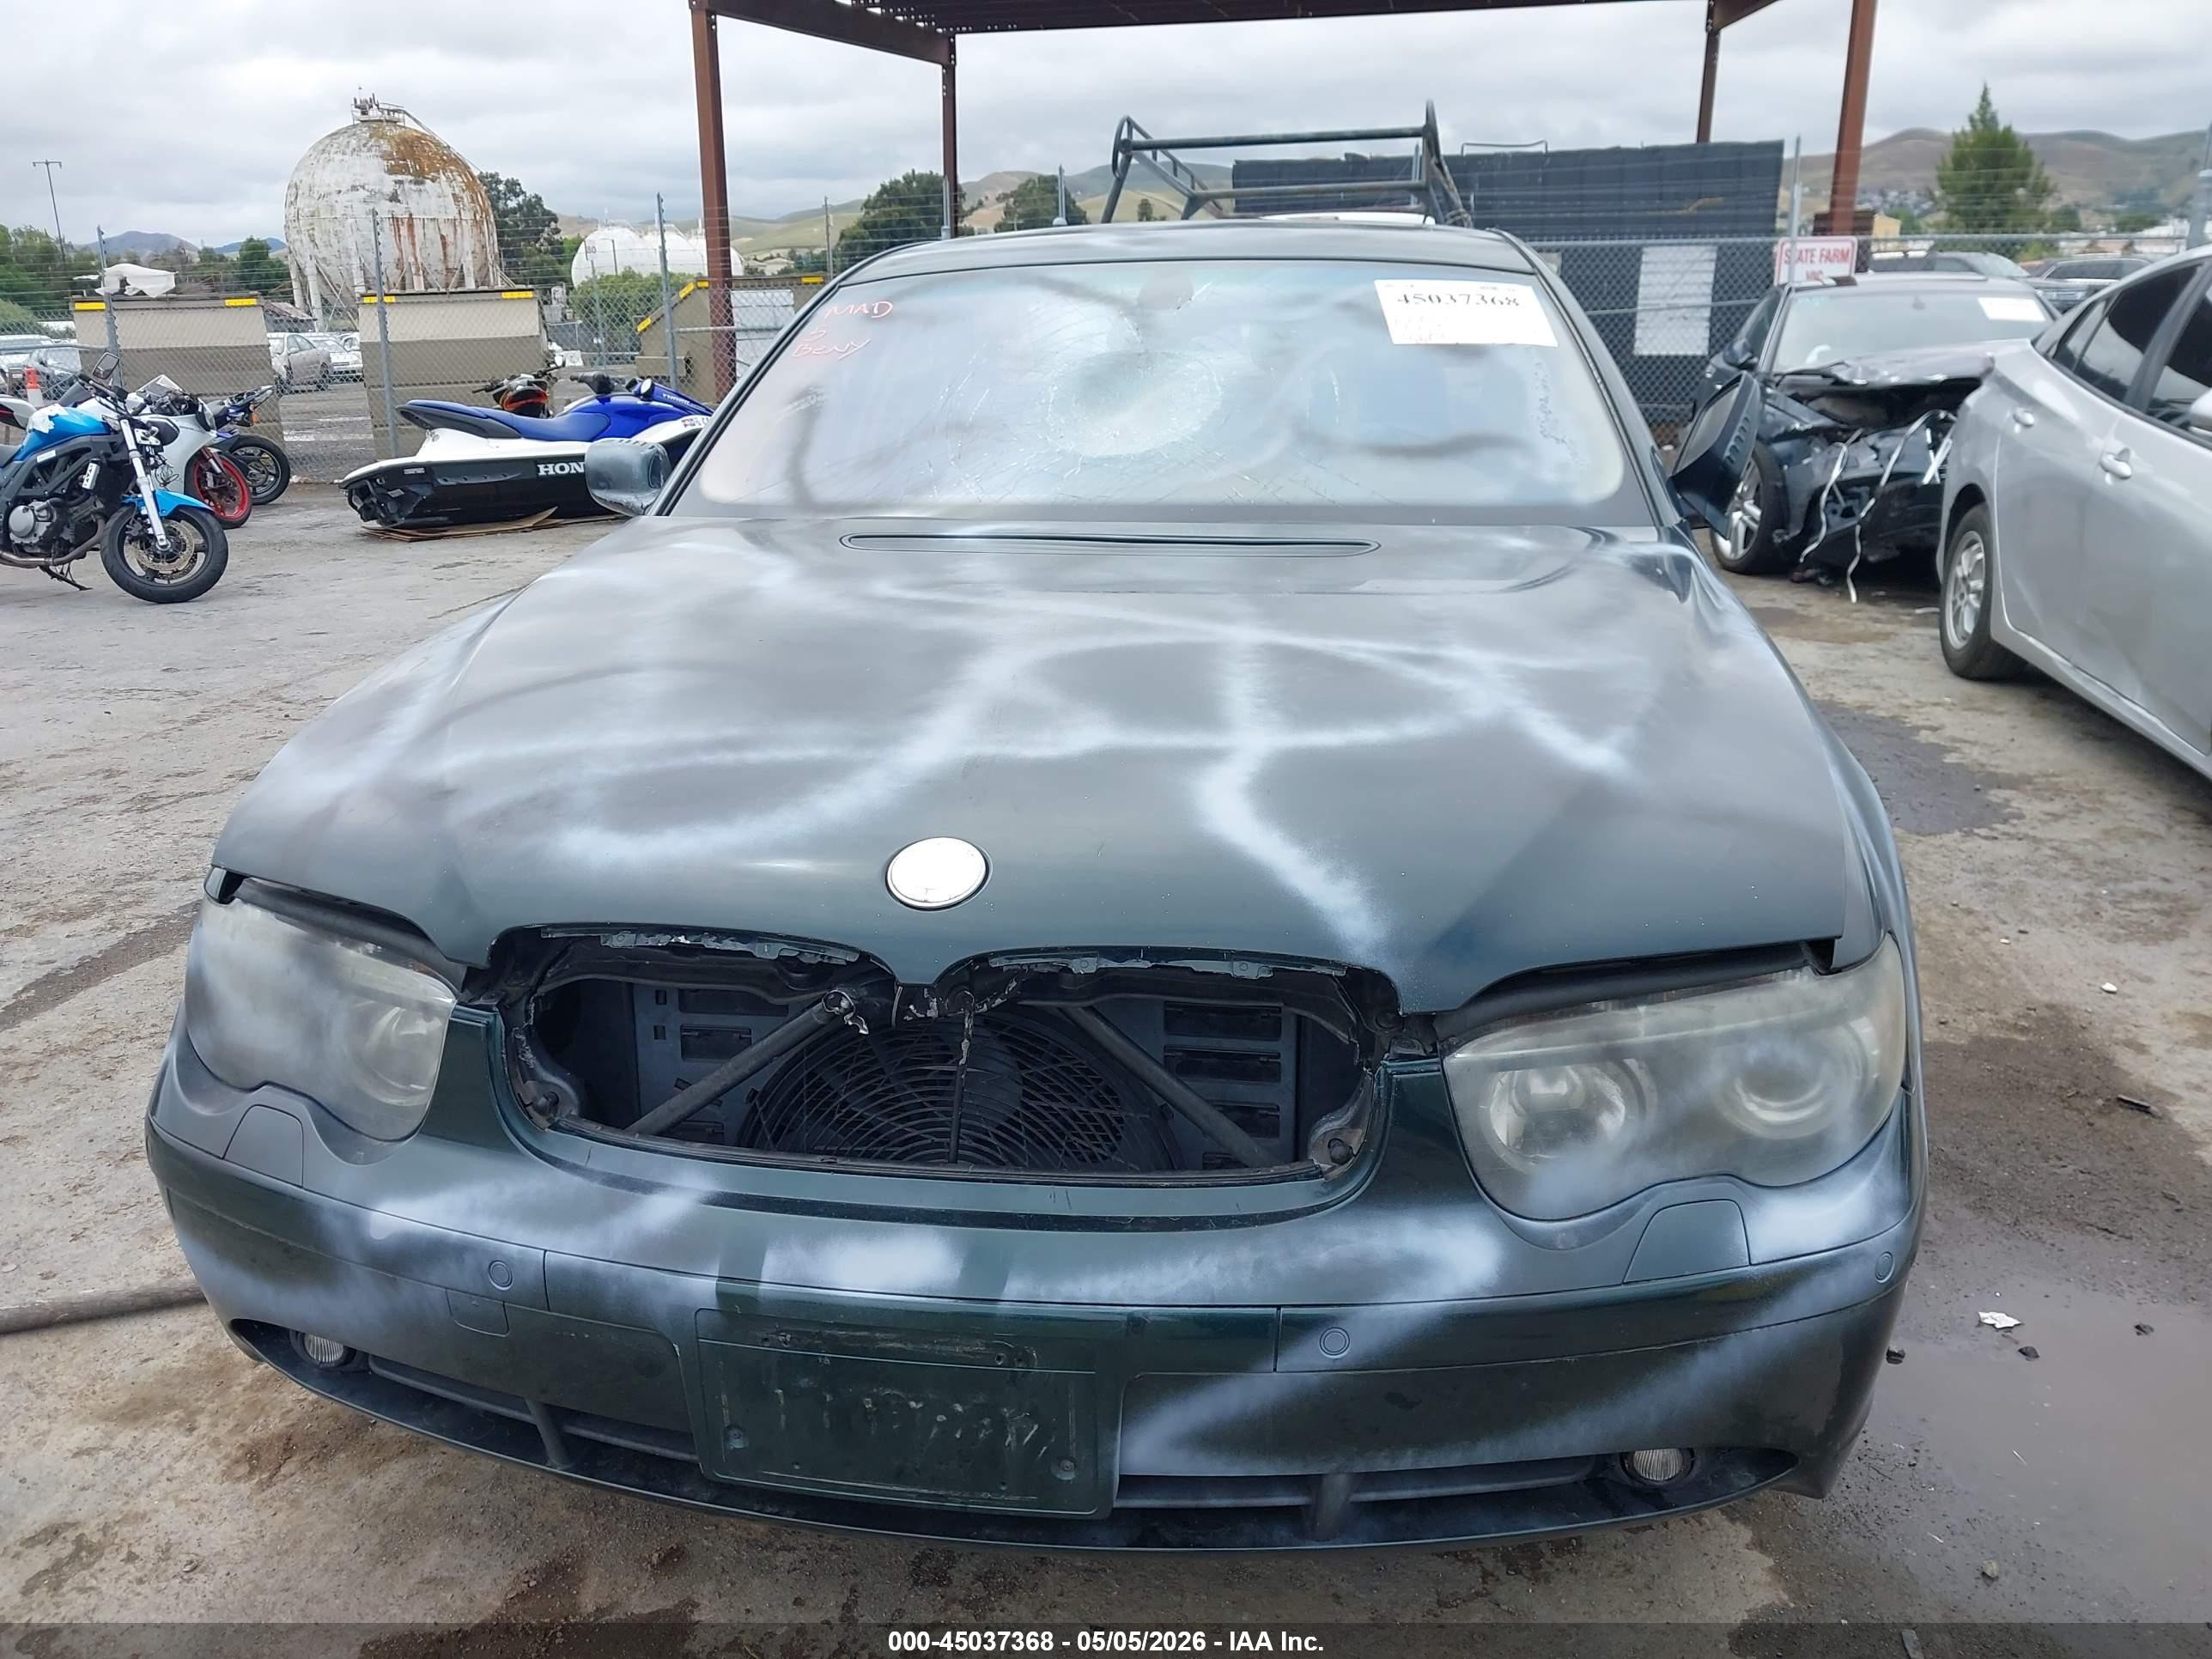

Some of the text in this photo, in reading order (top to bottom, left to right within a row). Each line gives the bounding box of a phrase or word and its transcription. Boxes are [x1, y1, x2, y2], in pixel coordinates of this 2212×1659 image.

[1784, 246, 1850, 264] SATE FARM
[1396, 294, 1521, 307] 45037368
